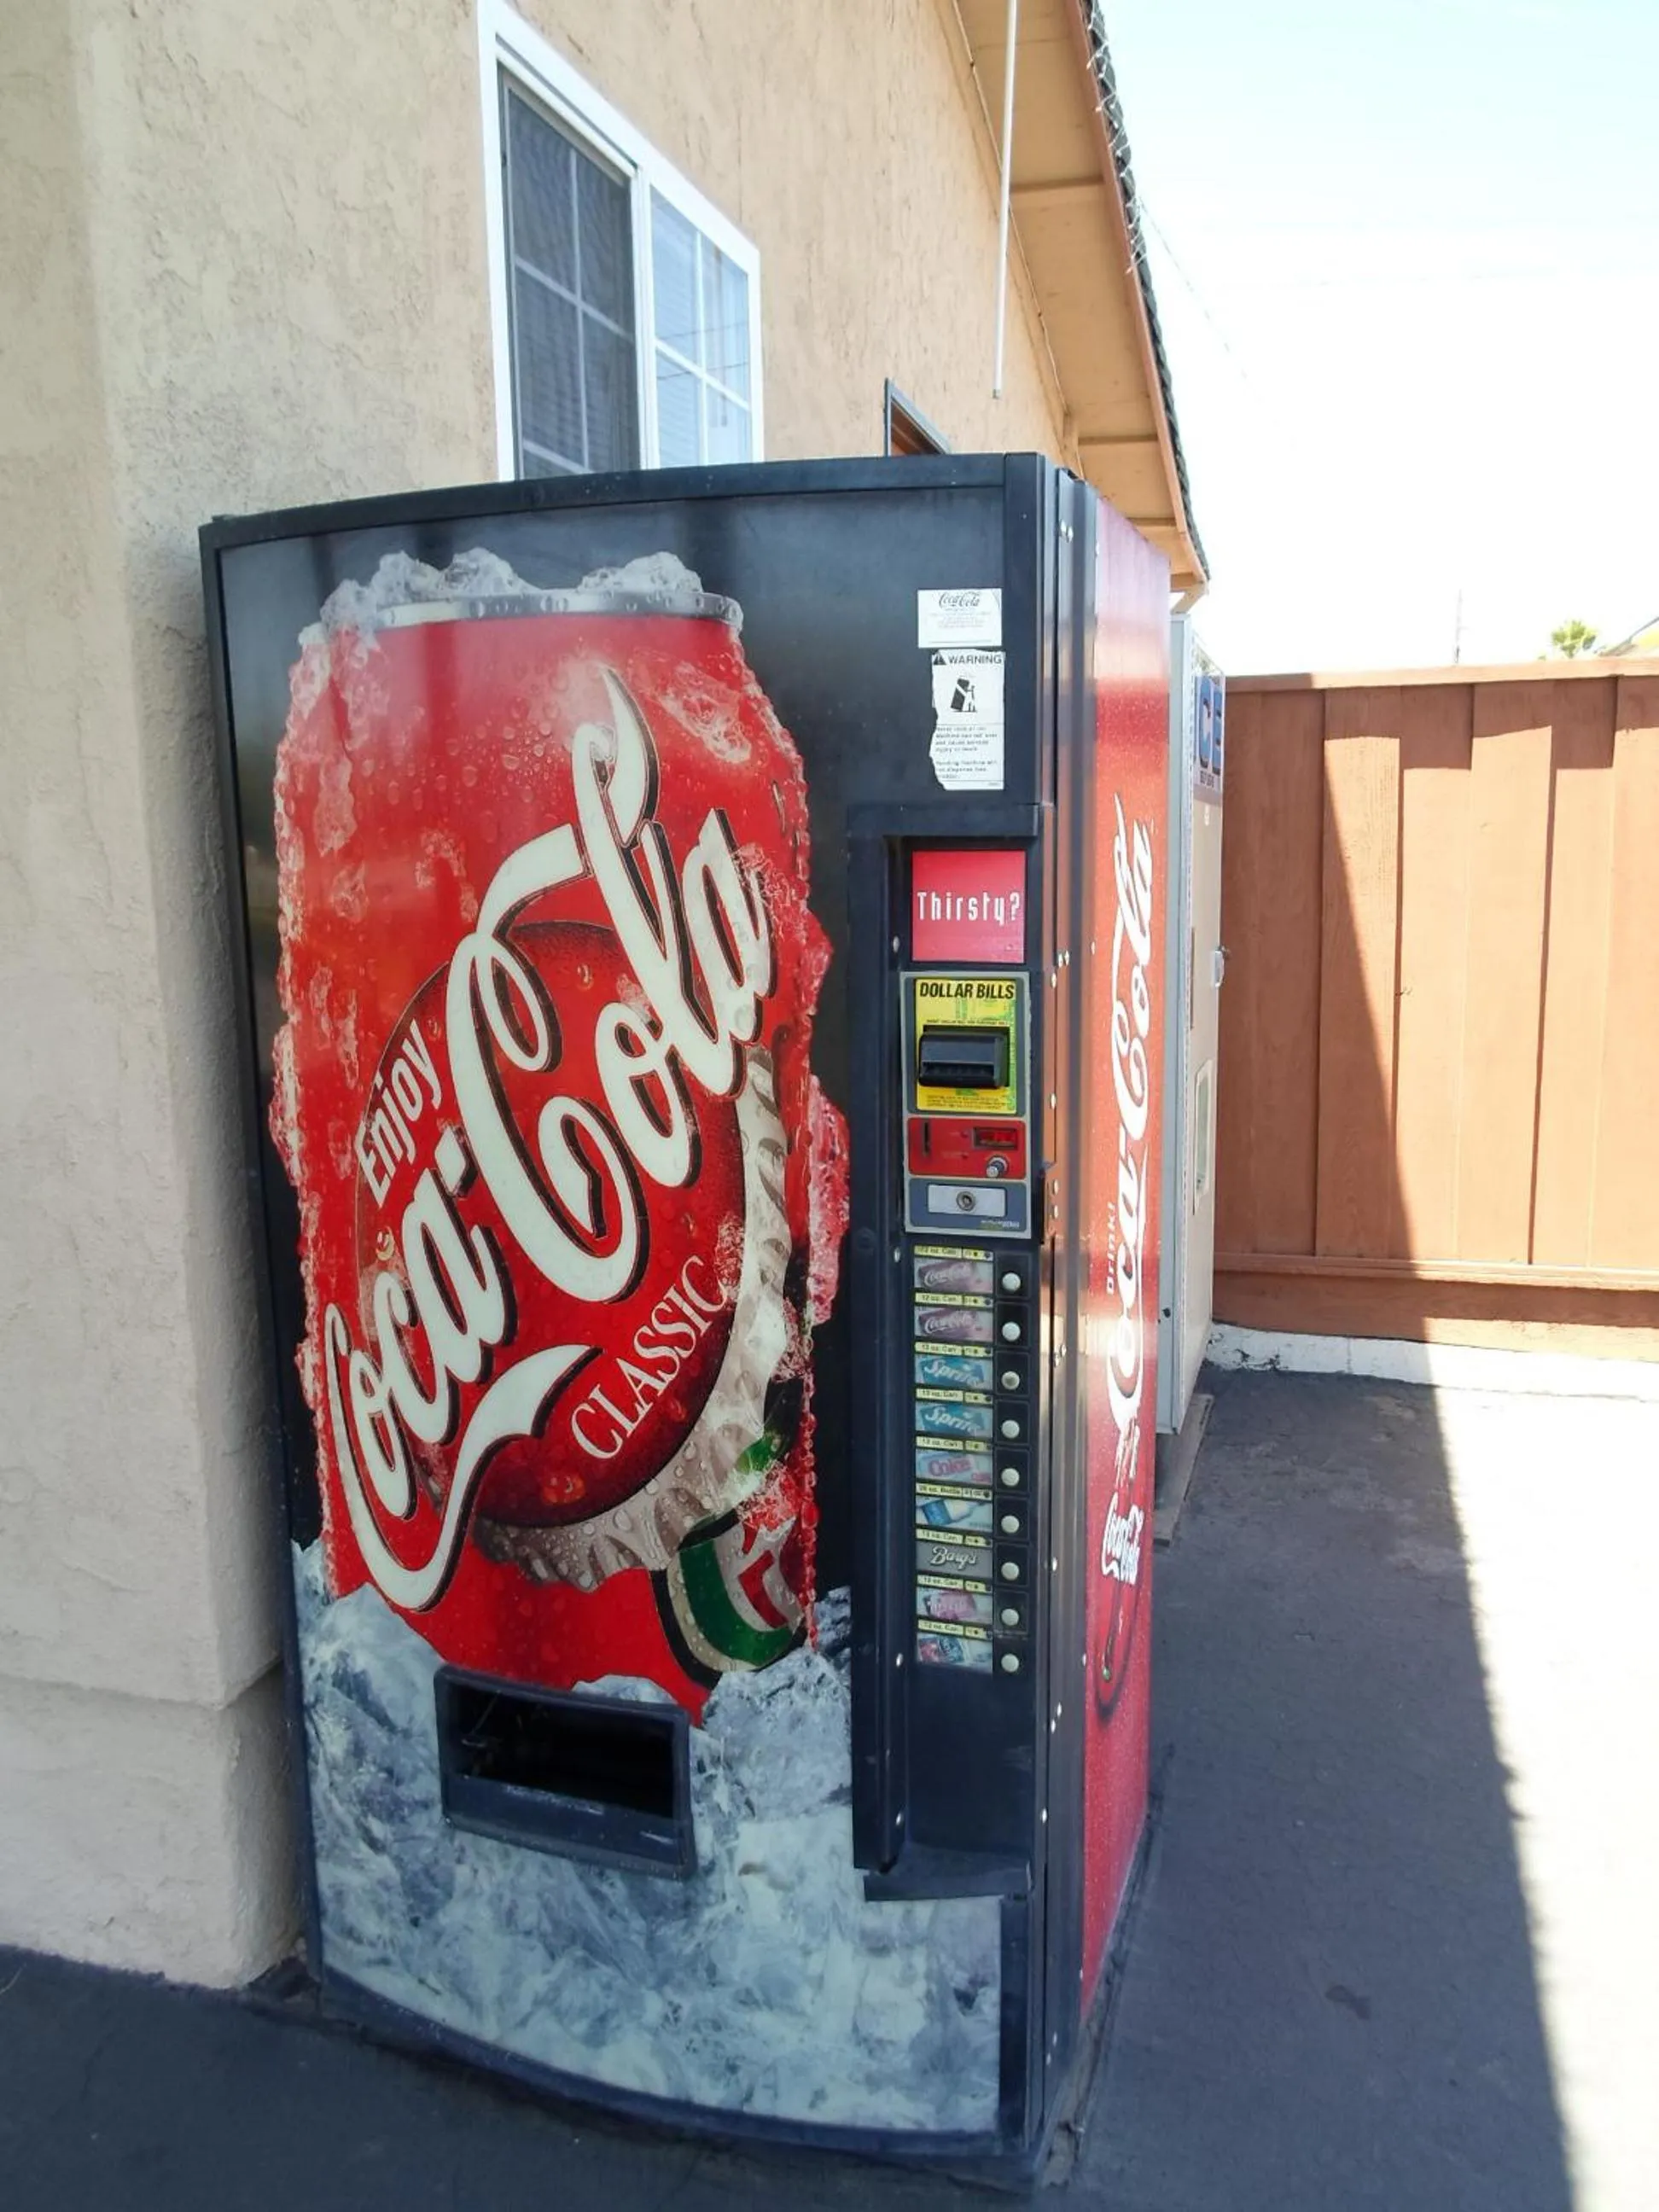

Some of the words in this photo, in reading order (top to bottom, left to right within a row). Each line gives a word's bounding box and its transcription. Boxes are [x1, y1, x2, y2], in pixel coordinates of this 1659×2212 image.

[948, 654, 1003, 666] WARNING
[1195, 676, 1223, 777] CE
[917, 891, 1021, 926] Thirsty?
[919, 981, 974, 998] DOLLAR
[975, 983, 1015, 999] BILLS
[353, 1017, 442, 1209] Enjoy
[324, 665, 774, 1612] Coca-Cola
[570, 1254, 726, 1459] CLASSIC
[923, 1359, 981, 1388] Sprite
[924, 1406, 981, 1435] Sprite
